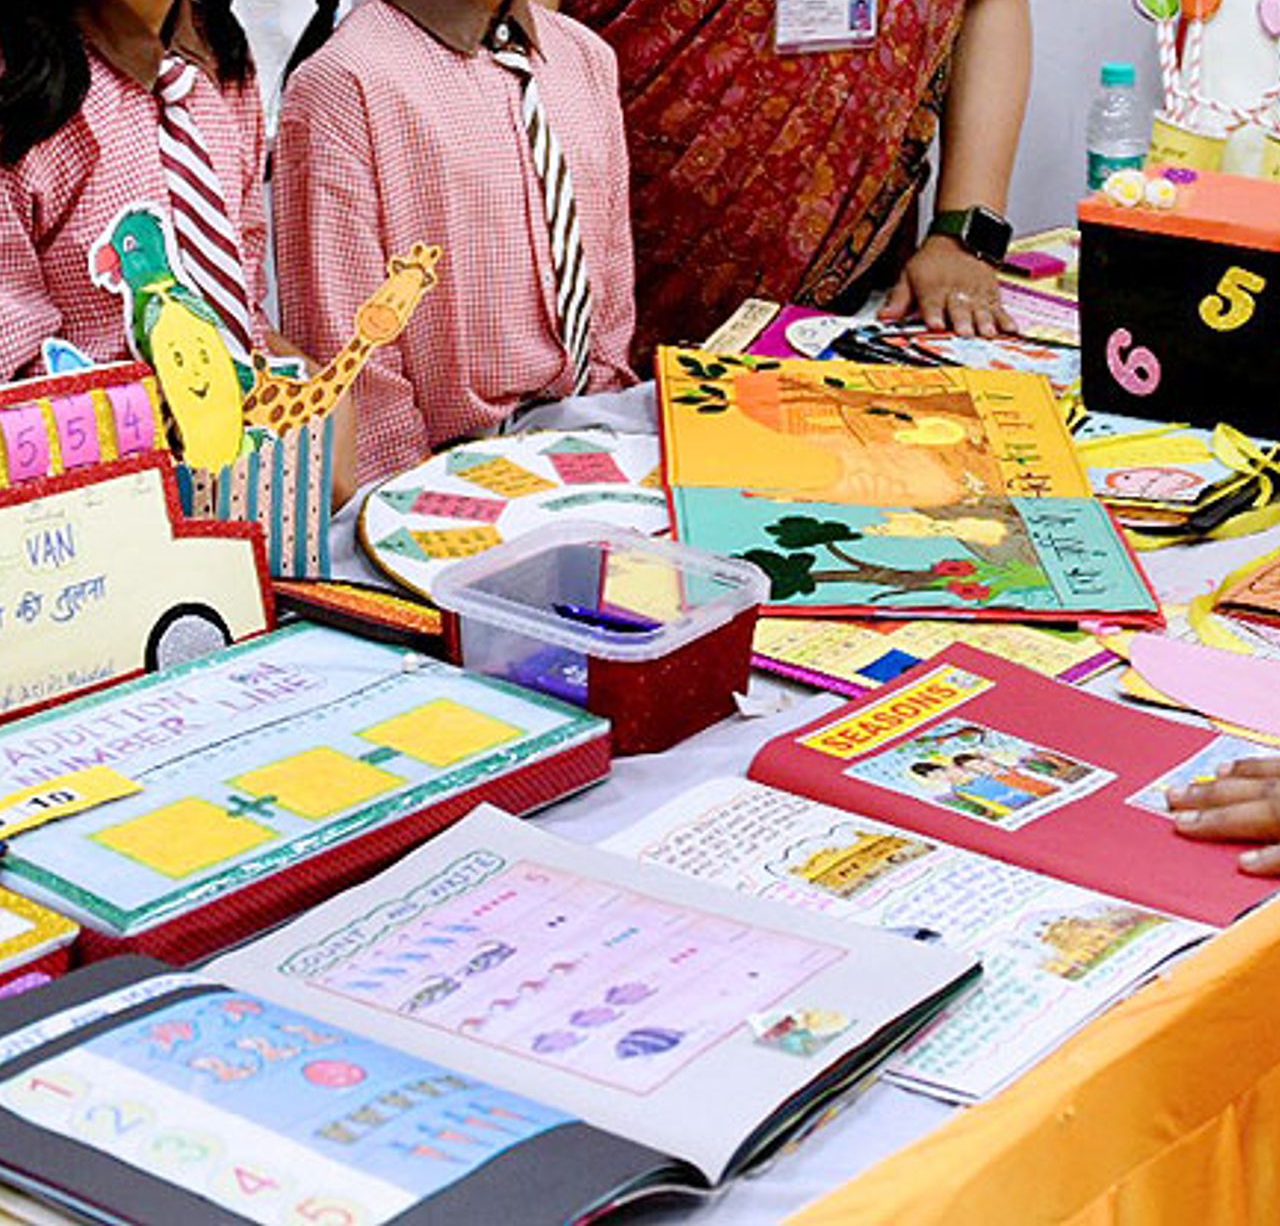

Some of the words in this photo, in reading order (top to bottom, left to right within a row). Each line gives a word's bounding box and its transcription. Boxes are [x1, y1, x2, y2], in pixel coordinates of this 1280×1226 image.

[1199, 266, 1266, 332] 5
[1106, 328, 1161, 396] 6
[17, 426, 39, 468] 5
[65, 416, 87, 451] 5
[123, 397, 143, 441] 4
[26, 523, 77, 568] VAN
[5, 689, 200, 766] ADDITION
[13, 714, 207, 789] NUMBER
[216, 673, 318, 714] LINE
[822, 682, 959, 751] SEASONS
[29, 791, 76, 810] 10
[29, 1077, 74, 1098] 1
[85, 1104, 144, 1134] 2
[151, 1134, 210, 1162] 3
[234, 1167, 280, 1196] 4
